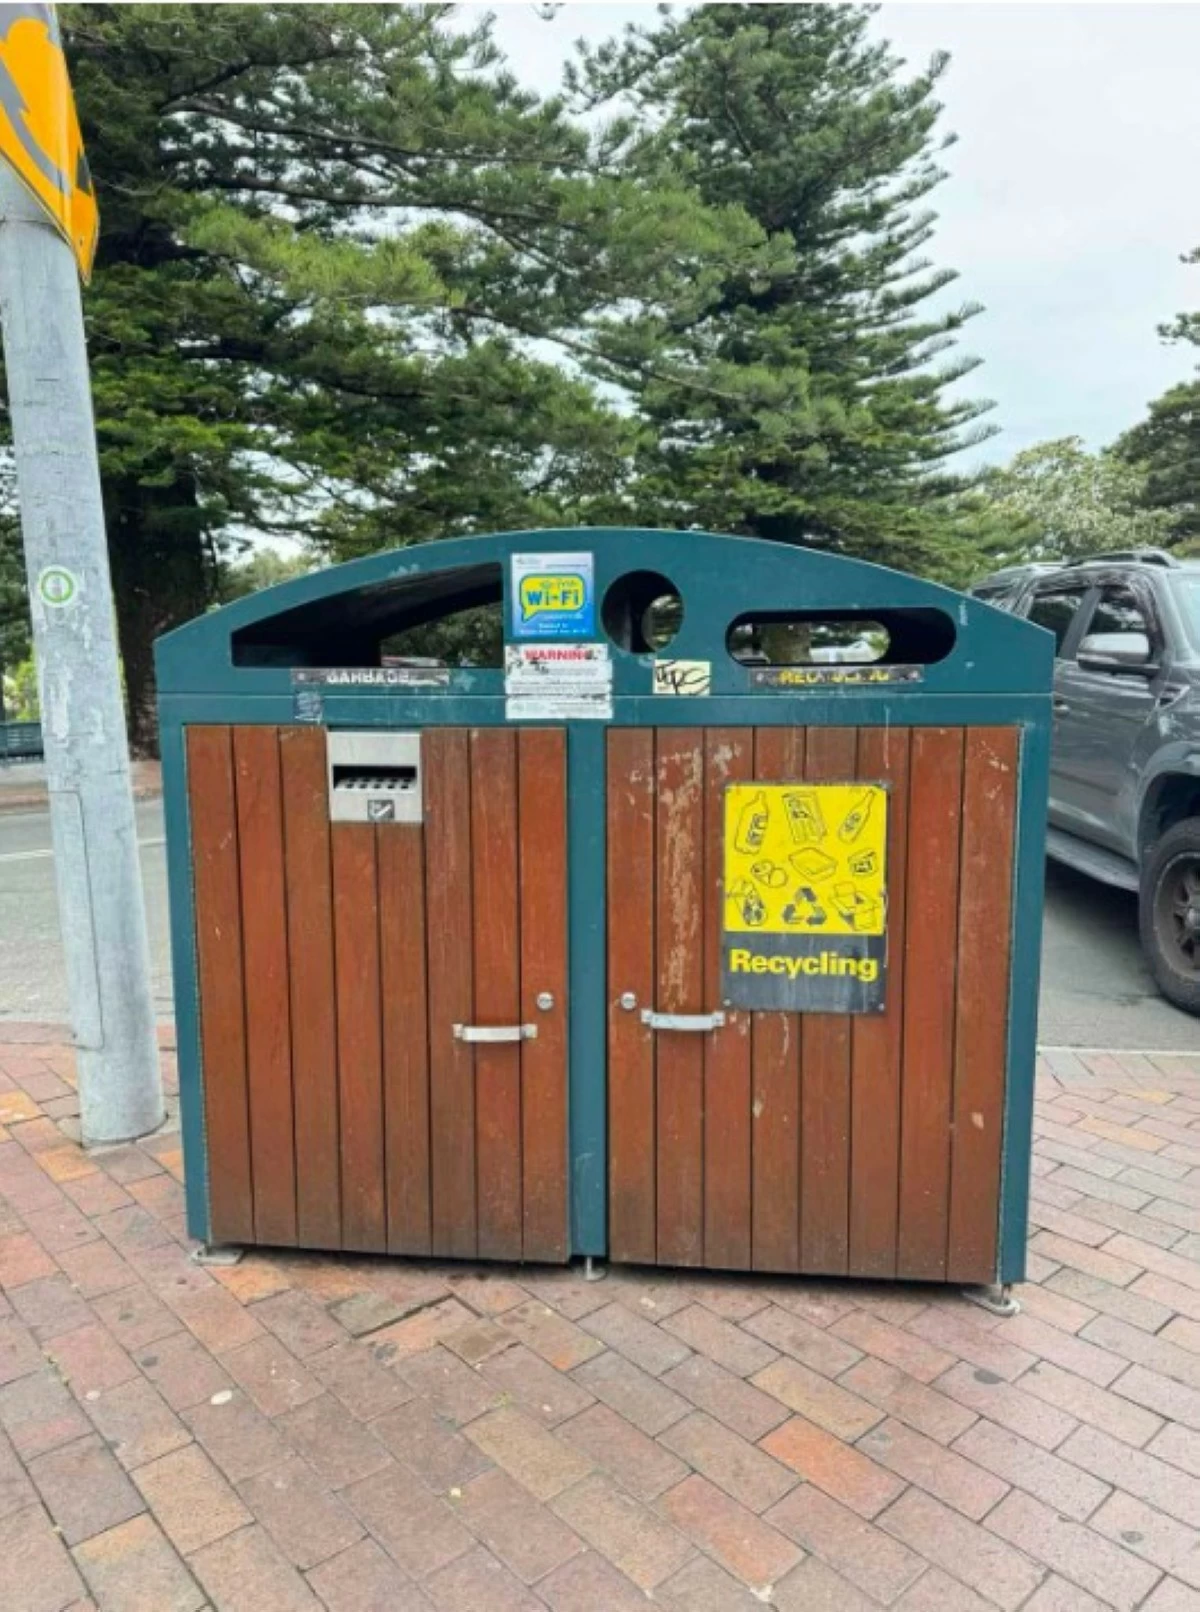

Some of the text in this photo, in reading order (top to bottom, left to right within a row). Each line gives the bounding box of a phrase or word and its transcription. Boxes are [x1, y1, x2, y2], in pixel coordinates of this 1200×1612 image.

[527, 589, 579, 606] Wi-Fi
[525, 649, 594, 660] WARNIN
[729, 948, 878, 982] Recycling
